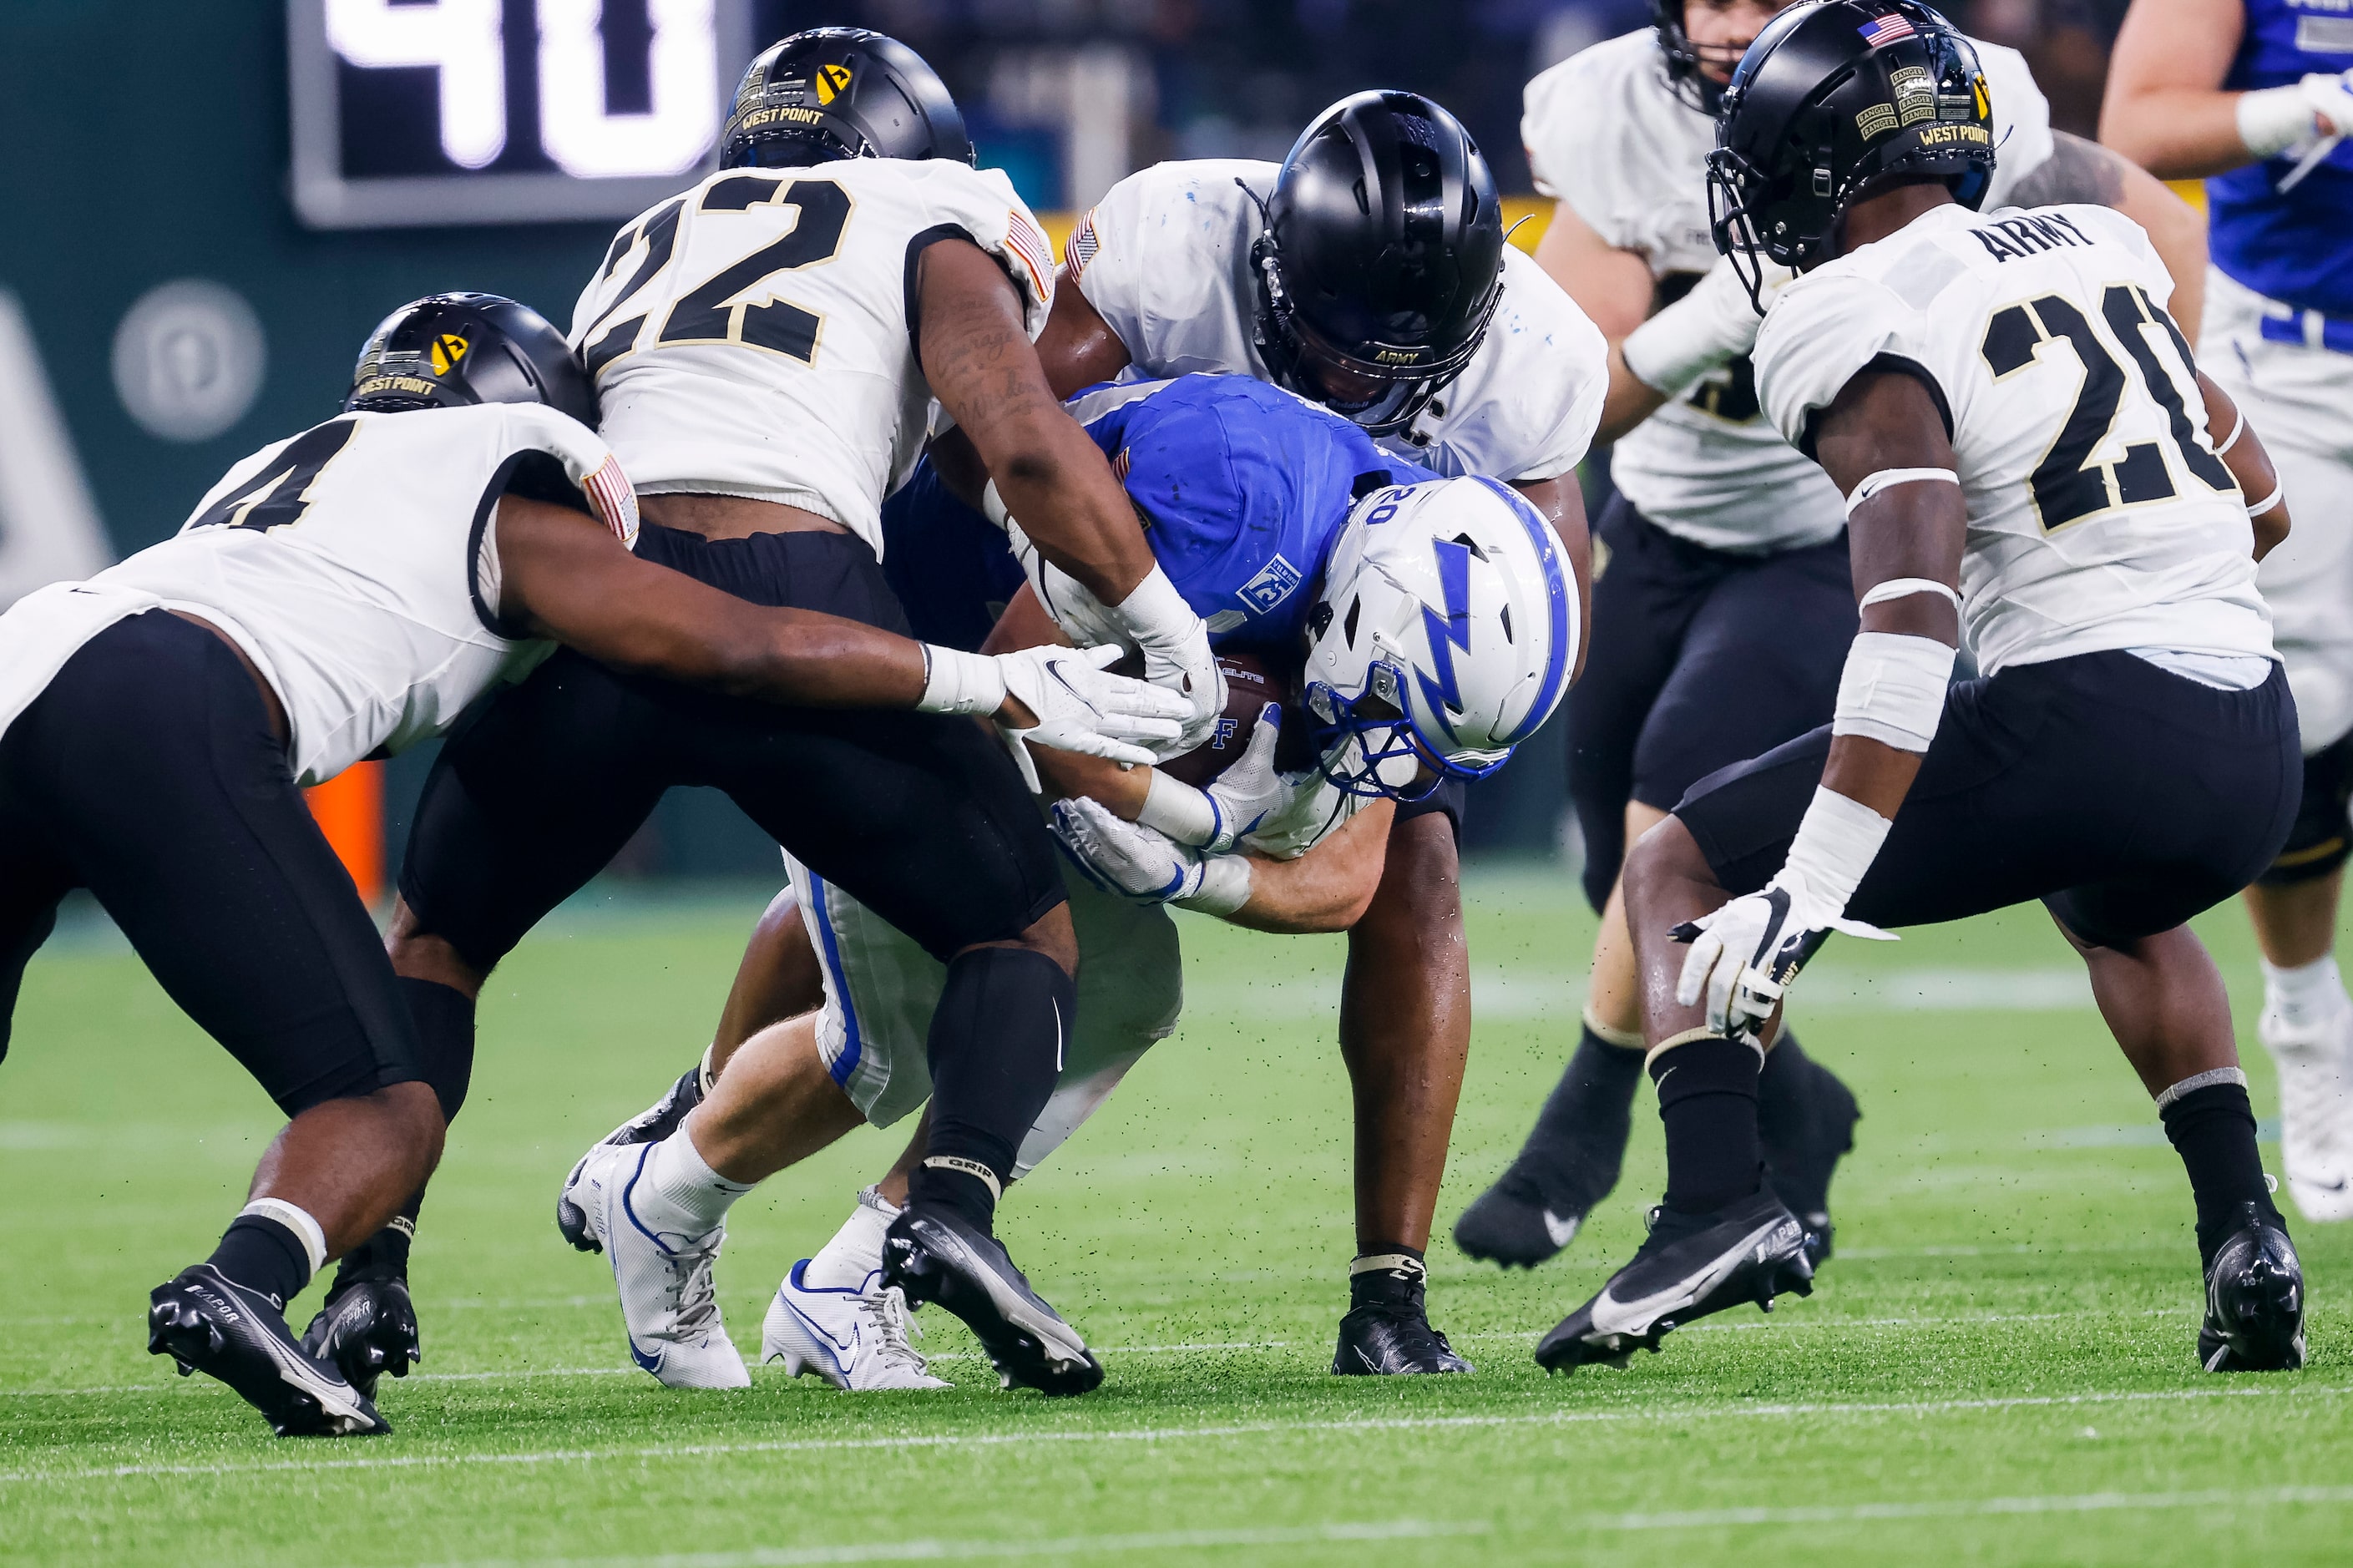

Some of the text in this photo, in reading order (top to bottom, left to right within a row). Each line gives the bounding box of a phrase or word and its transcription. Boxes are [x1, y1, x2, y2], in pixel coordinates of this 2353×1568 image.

[1893, 68, 1924, 82] RANGER
[1900, 96, 1932, 109] RANGER
[742, 109, 780, 130] WEST
[779, 108, 823, 125] POINT
[1859, 106, 1890, 122] RANGER
[1903, 109, 1934, 123] RANGER
[1863, 119, 1895, 136] RANGER
[1920, 126, 1989, 145] WEST POINT
[1968, 214, 2095, 263] ARMY
[574, 174, 857, 383] 22
[1374, 350, 1419, 365] ARMY
[358, 377, 437, 396] WEST POINT
[1977, 280, 2244, 538] 20
[187, 418, 366, 537] 4
[1366, 487, 1417, 526] 20
[1222, 667, 1265, 685] ELITE
[1212, 717, 1238, 750] F
[949, 1158, 992, 1179] GRIP
[184, 1284, 240, 1324] VAPOR
